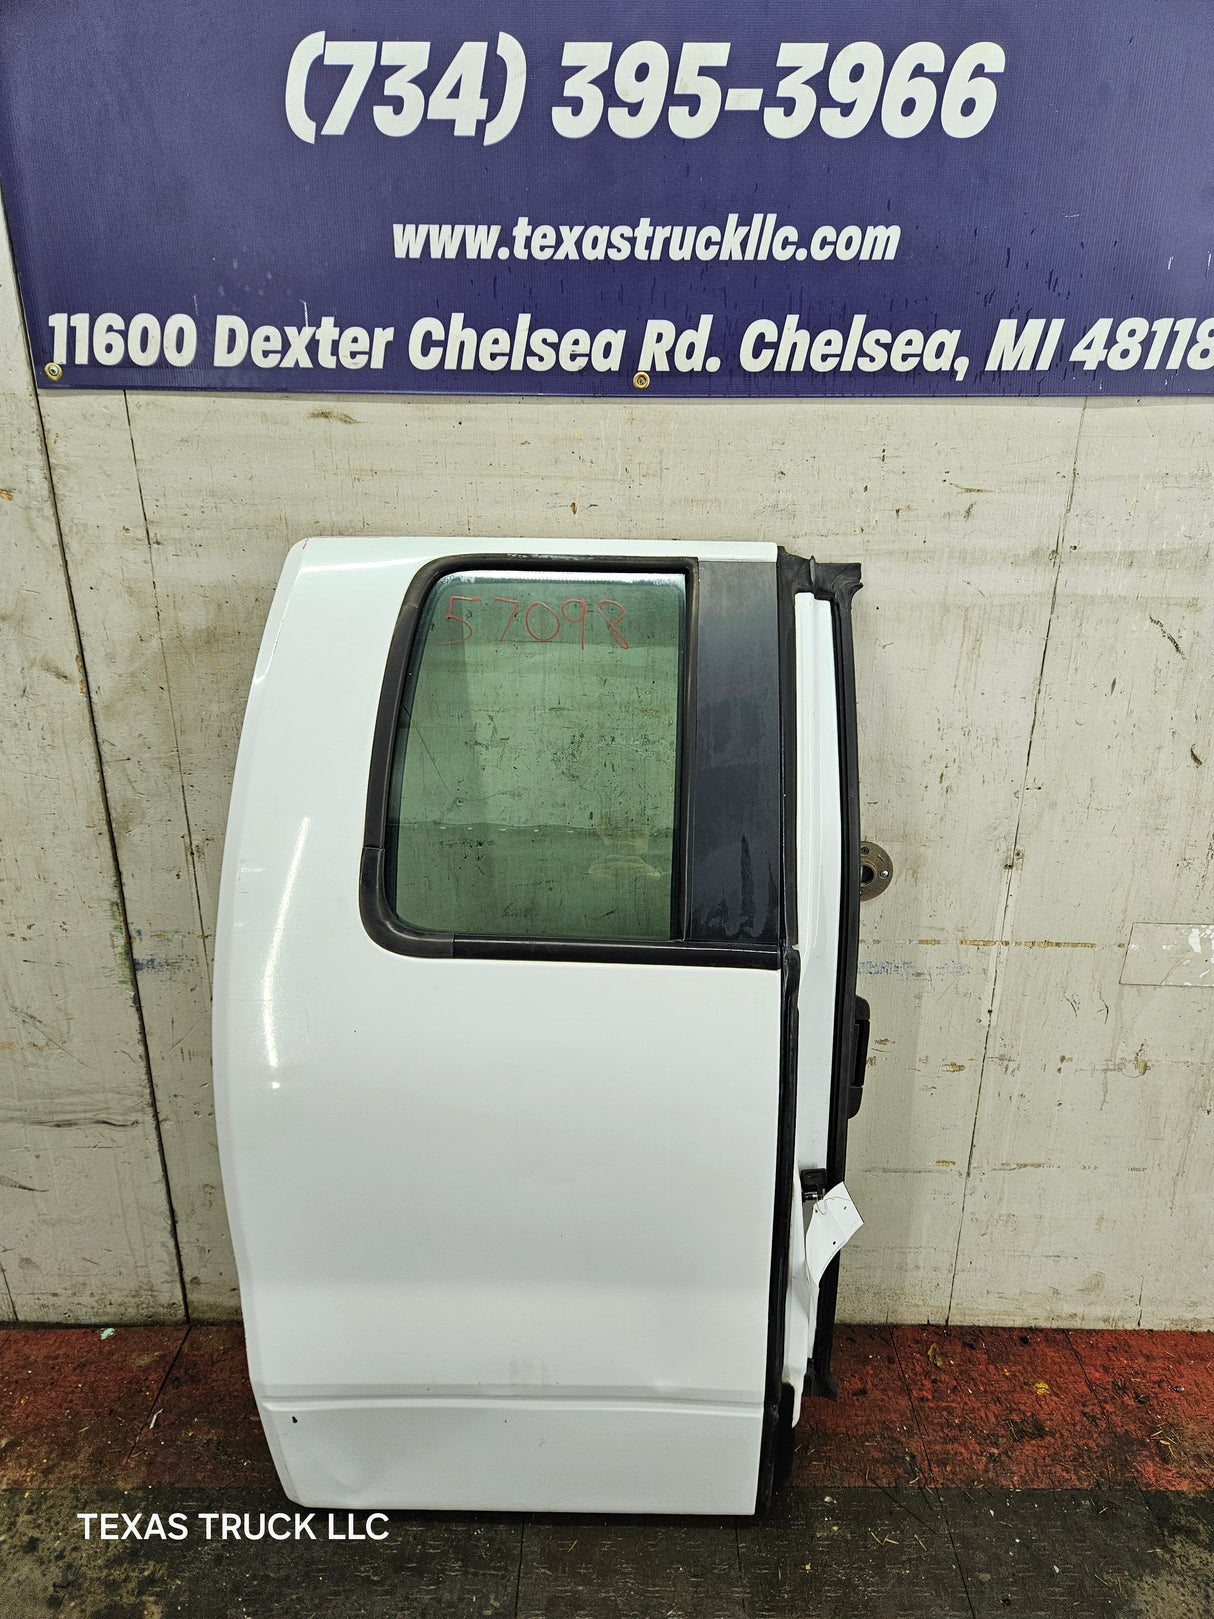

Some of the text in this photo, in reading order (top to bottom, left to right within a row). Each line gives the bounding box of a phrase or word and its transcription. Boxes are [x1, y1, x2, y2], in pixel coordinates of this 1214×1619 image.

[285, 31, 1006, 146] (734) 395-3966
[392, 213, 902, 262] www.texastruckllc.com
[48, 312, 1214, 382] 11600 Dexter Chelsea Rd. Chelsea, MI 48118
[438, 596, 630, 650] 57098
